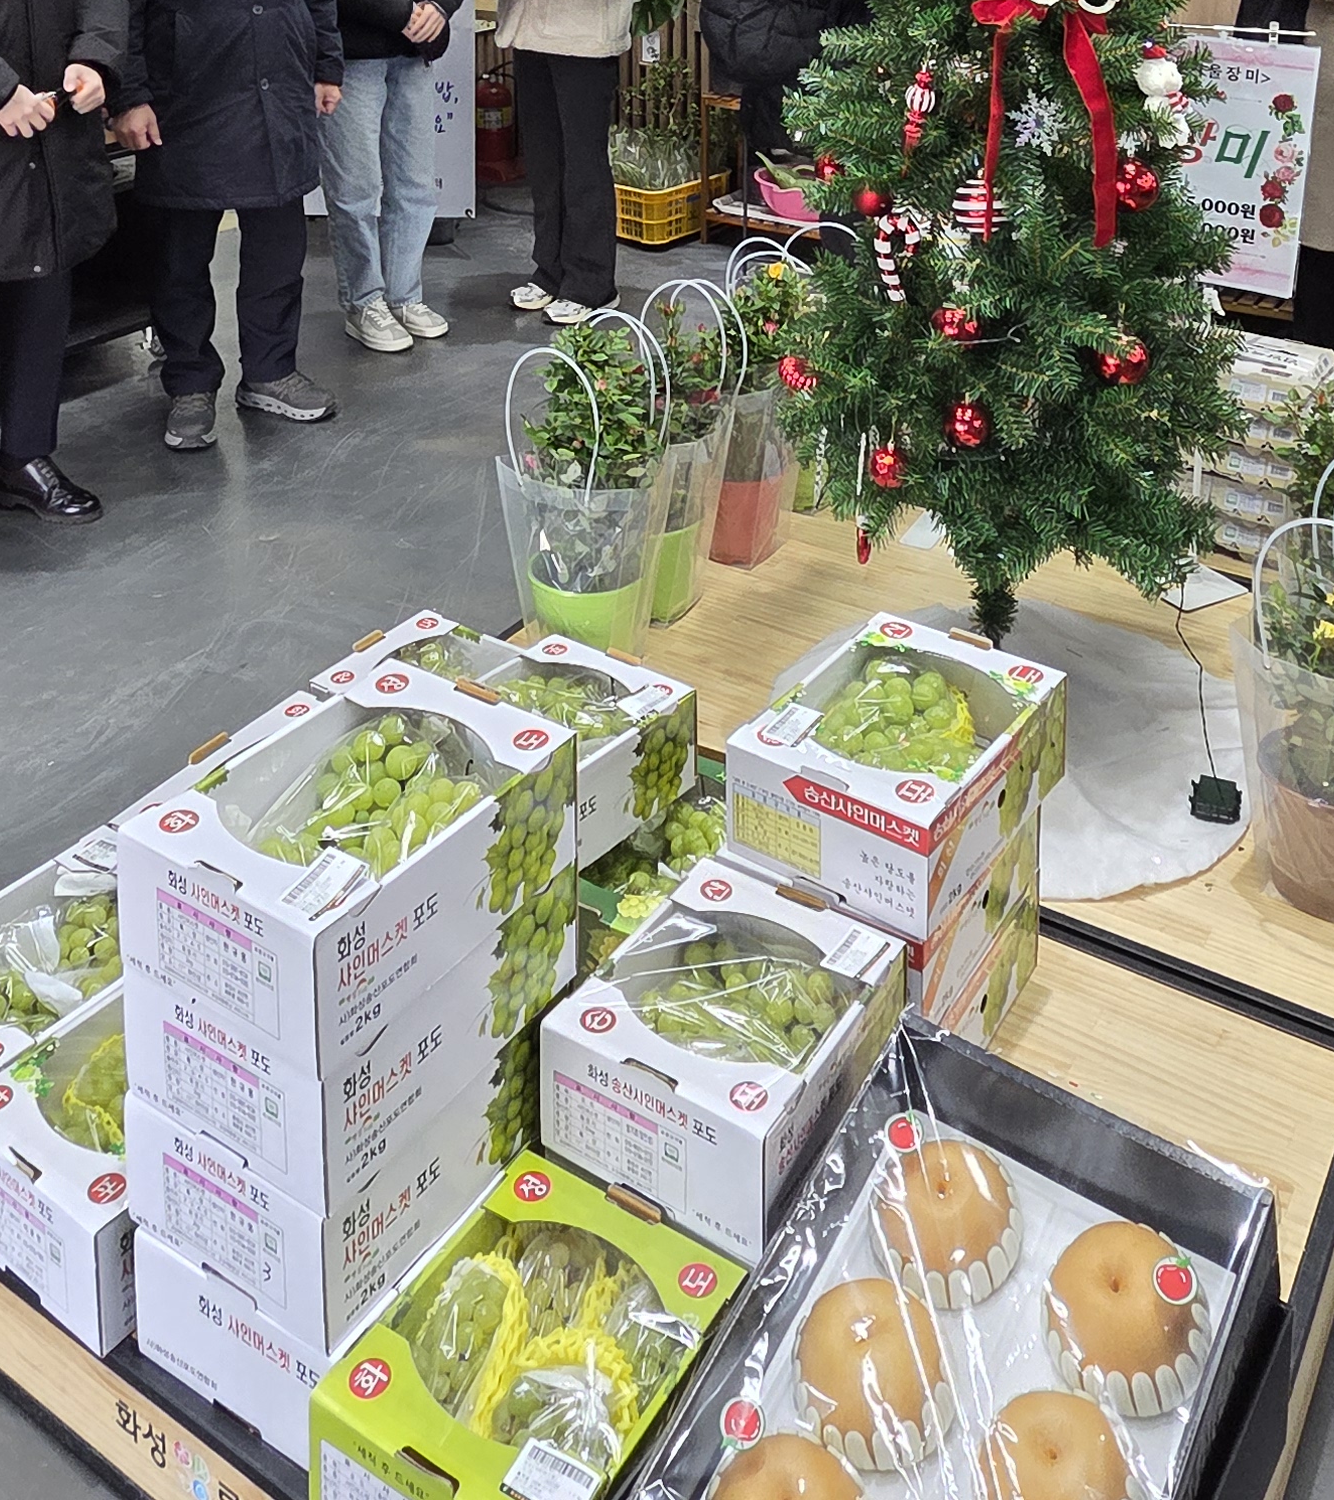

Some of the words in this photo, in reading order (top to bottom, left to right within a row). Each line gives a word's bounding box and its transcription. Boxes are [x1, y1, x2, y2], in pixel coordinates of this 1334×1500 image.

[579, 794, 597, 822] 포도
[168, 870, 187, 895] 화성
[244, 911, 264, 938] 포도
[413, 892, 438, 931] 포도
[337, 920, 366, 962] 화성
[355, 1003, 381, 1032] 2kg
[175, 1004, 194, 1029] 화성
[251, 1049, 271, 1076] 포도
[417, 1024, 442, 1065] 포도
[343, 1060, 371, 1104] 화성
[587, 1063, 609, 1087] 화성
[692, 1118, 717, 1145] 포도
[174, 1137, 193, 1162] 화성
[250, 1184, 270, 1212] 포도
[361, 1138, 387, 1169] 2kg
[416, 1156, 441, 1199] 포도
[342, 1198, 371, 1243] 화성
[361, 1272, 386, 1306] 2kg
[198, 1295, 223, 1327] 화성
[115, 1400, 166, 1468] 화성
